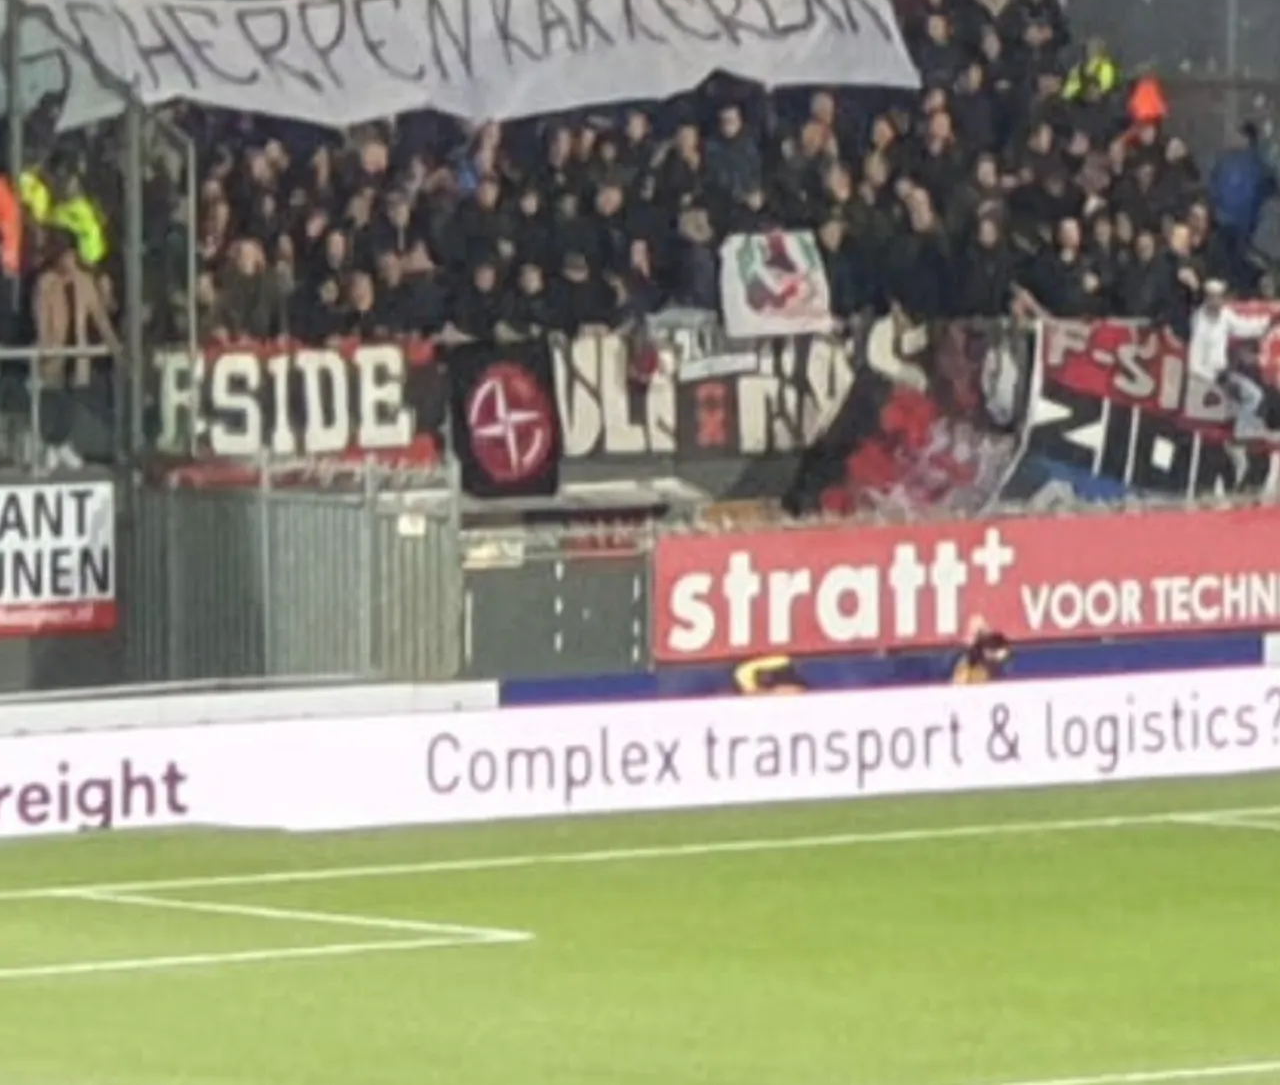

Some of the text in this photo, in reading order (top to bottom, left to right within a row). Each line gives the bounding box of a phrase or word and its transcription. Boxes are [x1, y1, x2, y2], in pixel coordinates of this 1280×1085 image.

[1023, 579, 1144, 630] VOOR
[426, 726, 681, 804] Complex
[704, 719, 964, 789] transport
[986, 703, 1021, 763] &
